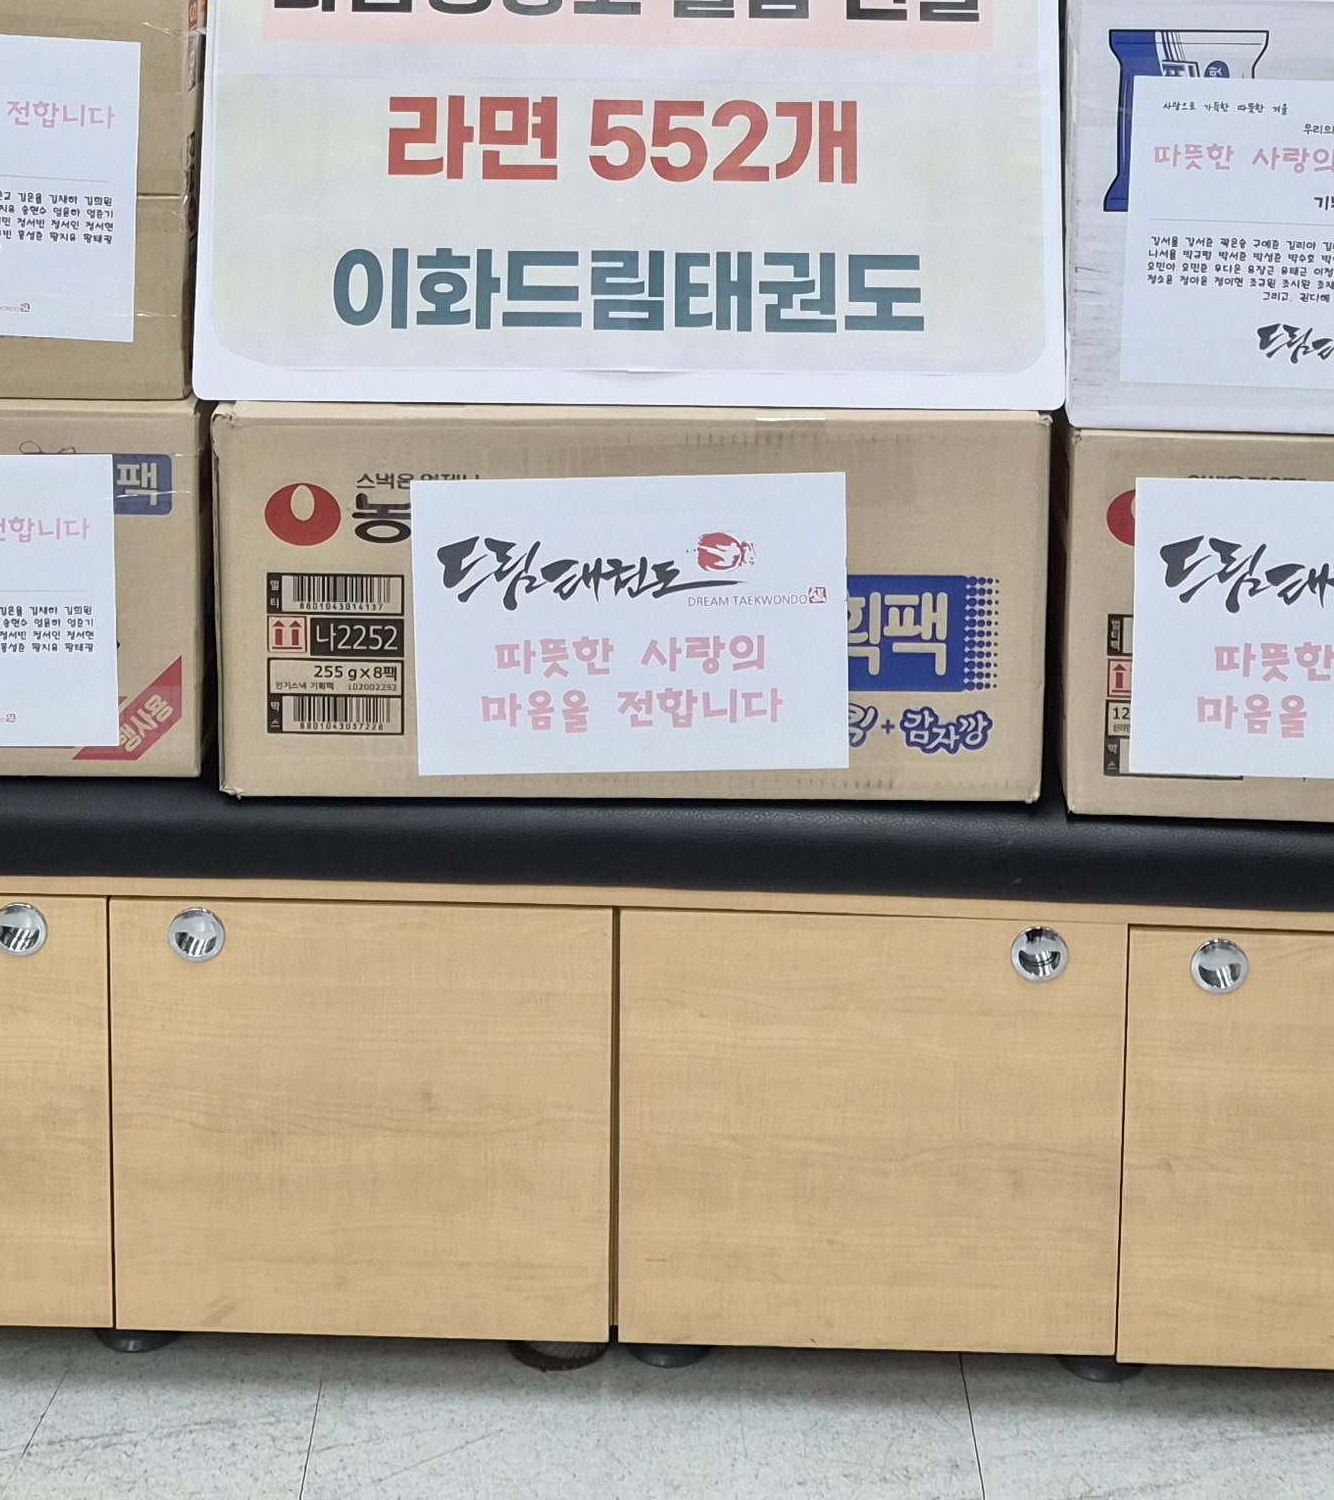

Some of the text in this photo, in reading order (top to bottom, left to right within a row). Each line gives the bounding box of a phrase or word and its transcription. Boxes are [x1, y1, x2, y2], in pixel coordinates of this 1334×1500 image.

[7, 101, 115, 129] 전합니다
[388, 95, 857, 184] 라면 552개
[1154, 143, 1234, 170] 따뜻한
[333, 248, 924, 333] 이화드림태권도
[116, 462, 157, 506] 팩
[688, 594, 808, 608] DREAM TAEKWONDO
[317, 623, 397, 651] 나2252
[495, 635, 764, 678] 따뜻한 사랑의
[314, 665, 343, 678] 255
[481, 687, 783, 733] 마음을 전합니다
[902, 708, 990, 752] 감자깡
[1197, 694, 1307, 738] 마음을
